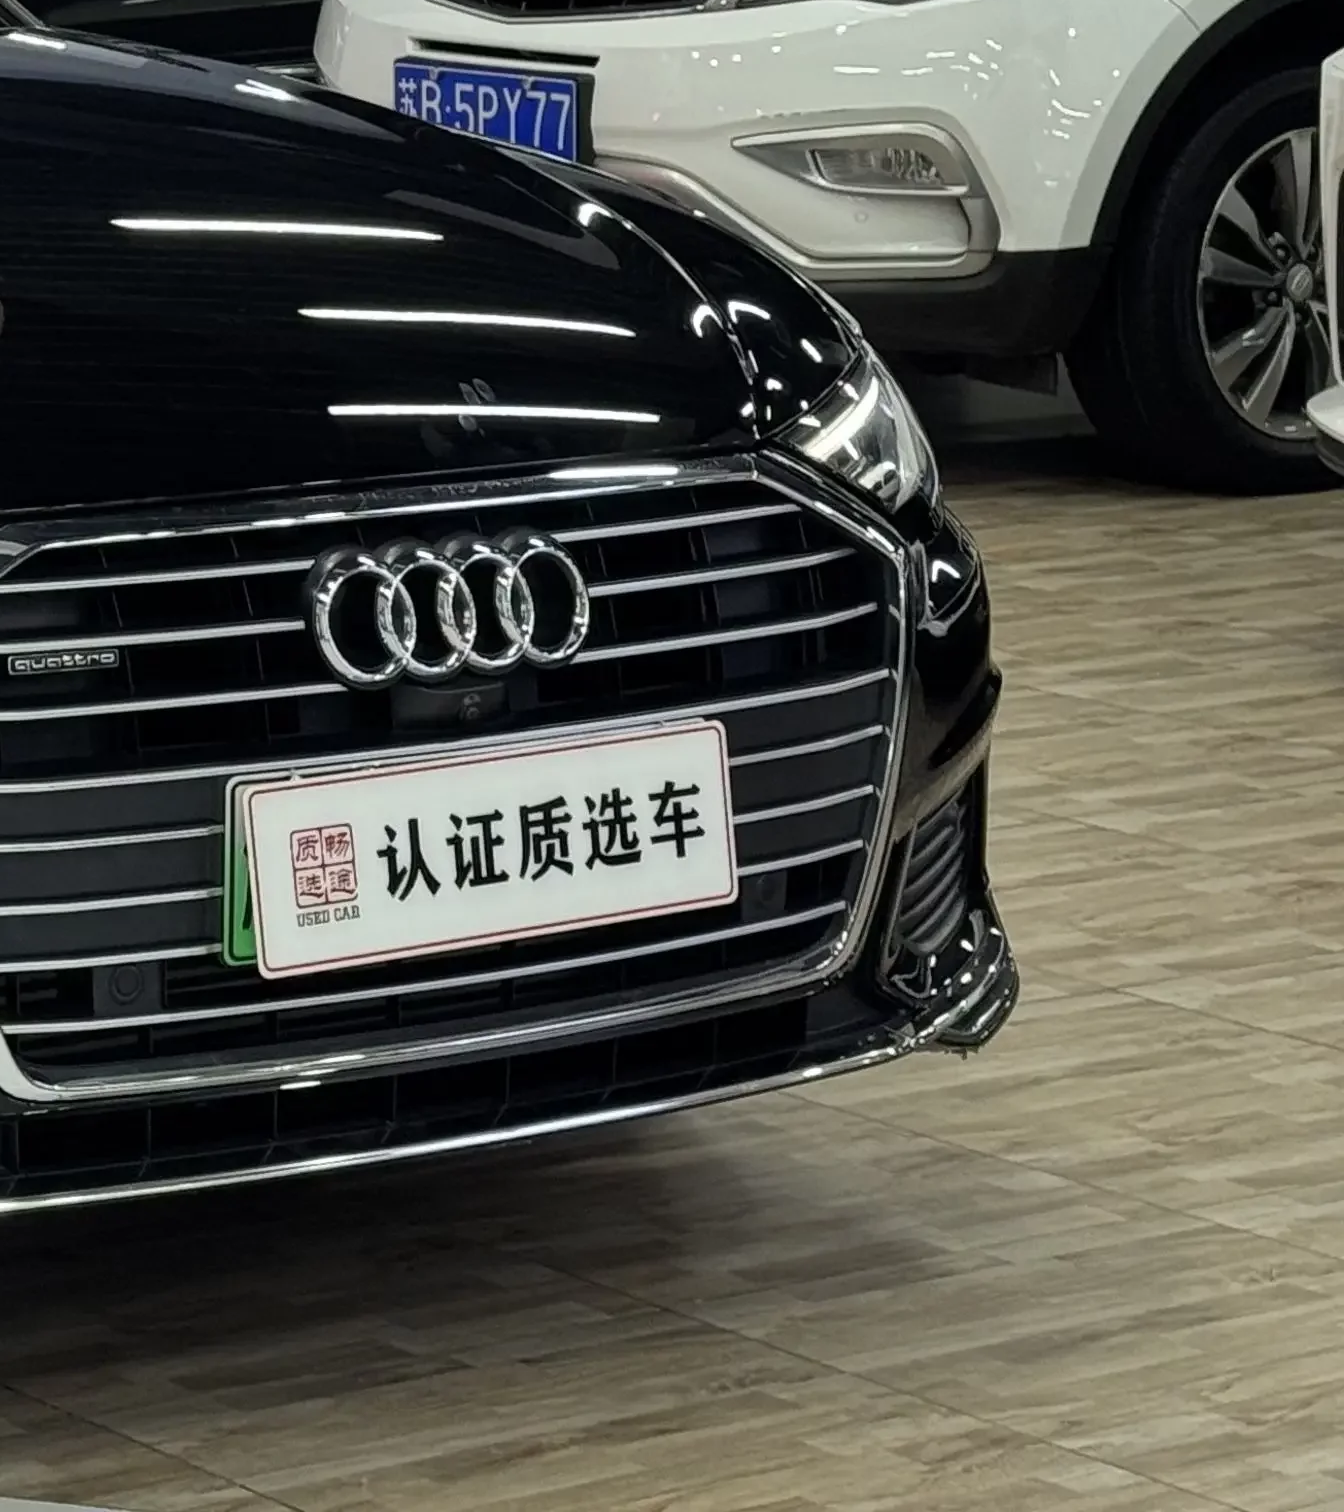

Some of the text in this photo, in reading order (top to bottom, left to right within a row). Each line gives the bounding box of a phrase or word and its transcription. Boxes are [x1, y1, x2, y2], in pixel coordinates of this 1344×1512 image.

[14, 652, 115, 672] quattro
[377, 781, 706, 901] 认证质选车
[296, 910, 330, 928] USED
